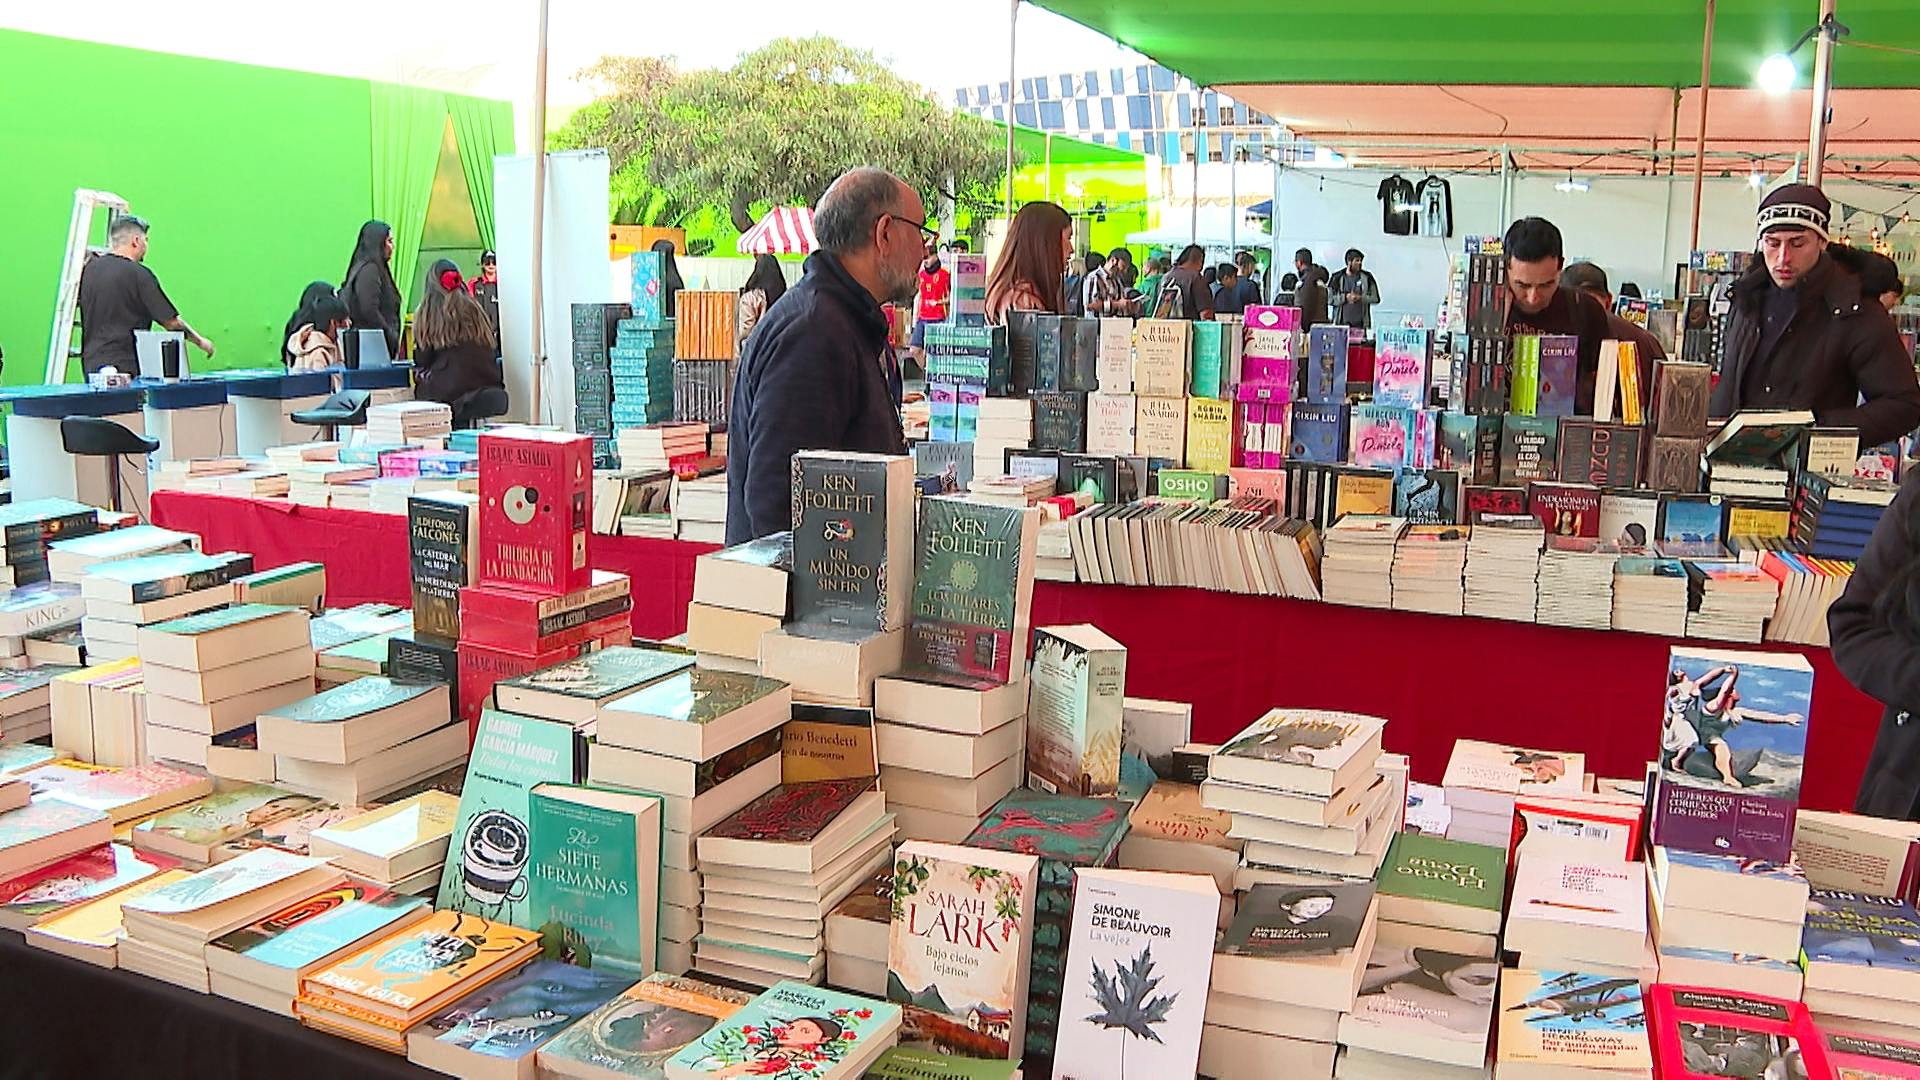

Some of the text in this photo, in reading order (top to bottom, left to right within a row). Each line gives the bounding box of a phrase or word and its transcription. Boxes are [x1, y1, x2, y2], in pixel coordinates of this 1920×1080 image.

[1542, 348, 1561, 356] CIXIN
[1193, 412, 1227, 422] SHARMA
[1197, 405, 1223, 414] ROBIN
[1295, 412, 1336, 423] CIXIN LIU
[1523, 436, 1545, 444] VERDAD
[486, 445, 552, 468] ISAAC ASIMOV
[823, 474, 856, 492] KEN
[1164, 478, 1208, 492] OSHO
[803, 489, 875, 513] FOLLETT
[416, 516, 456, 532] ILDEFONSO
[951, 517, 987, 536] KEN
[413, 525, 460, 545] FALCONES
[830, 548, 848, 560] UN
[930, 530, 1007, 560] FOLLETT
[422, 549, 458, 564] CATEDRAL
[433, 561, 450, 571] MAR
[486, 560, 498, 578] LA
[809, 560, 870, 579] MUNDO
[817, 577, 861, 593] SIN FIN
[927, 589, 1001, 612] LOS PILARES
[25, 606, 62, 628] KING
[920, 602, 937, 615] DE
[940, 604, 955, 617] LA
[958, 606, 1007, 629] TIERRA
[486, 716, 523, 738] GABRIEL
[807, 731, 858, 748] Benedetti
[810, 751, 845, 761] nosotros
[1669, 798, 1730, 814] CORREN CON
[1670, 789, 1735, 807] MUJERES QUE
[1669, 806, 1718, 819] LOS LOBOS
[558, 848, 601, 870] SIETE
[1408, 856, 1479, 878] Deus
[536, 862, 628, 897] HERMANAS
[1396, 864, 1486, 890] Homo
[926, 890, 985, 916] SARAH
[1864, 895, 1904, 906] LIU
[550, 905, 615, 930] Lucinda
[1093, 903, 1141, 921] SIMONE
[908, 903, 1001, 953] LARK
[1091, 916, 1172, 938] DE BEAUVOIR
[1089, 929, 1131, 946] La vejez
[926, 944, 979, 967] Bajo cielos
[933, 960, 969, 979] lejanos
[777, 988, 826, 1006] MARCELA
[1683, 993, 1777, 1011] Alejandro Zambra
[1542, 1033, 1623, 1044] HEMINGWAY
